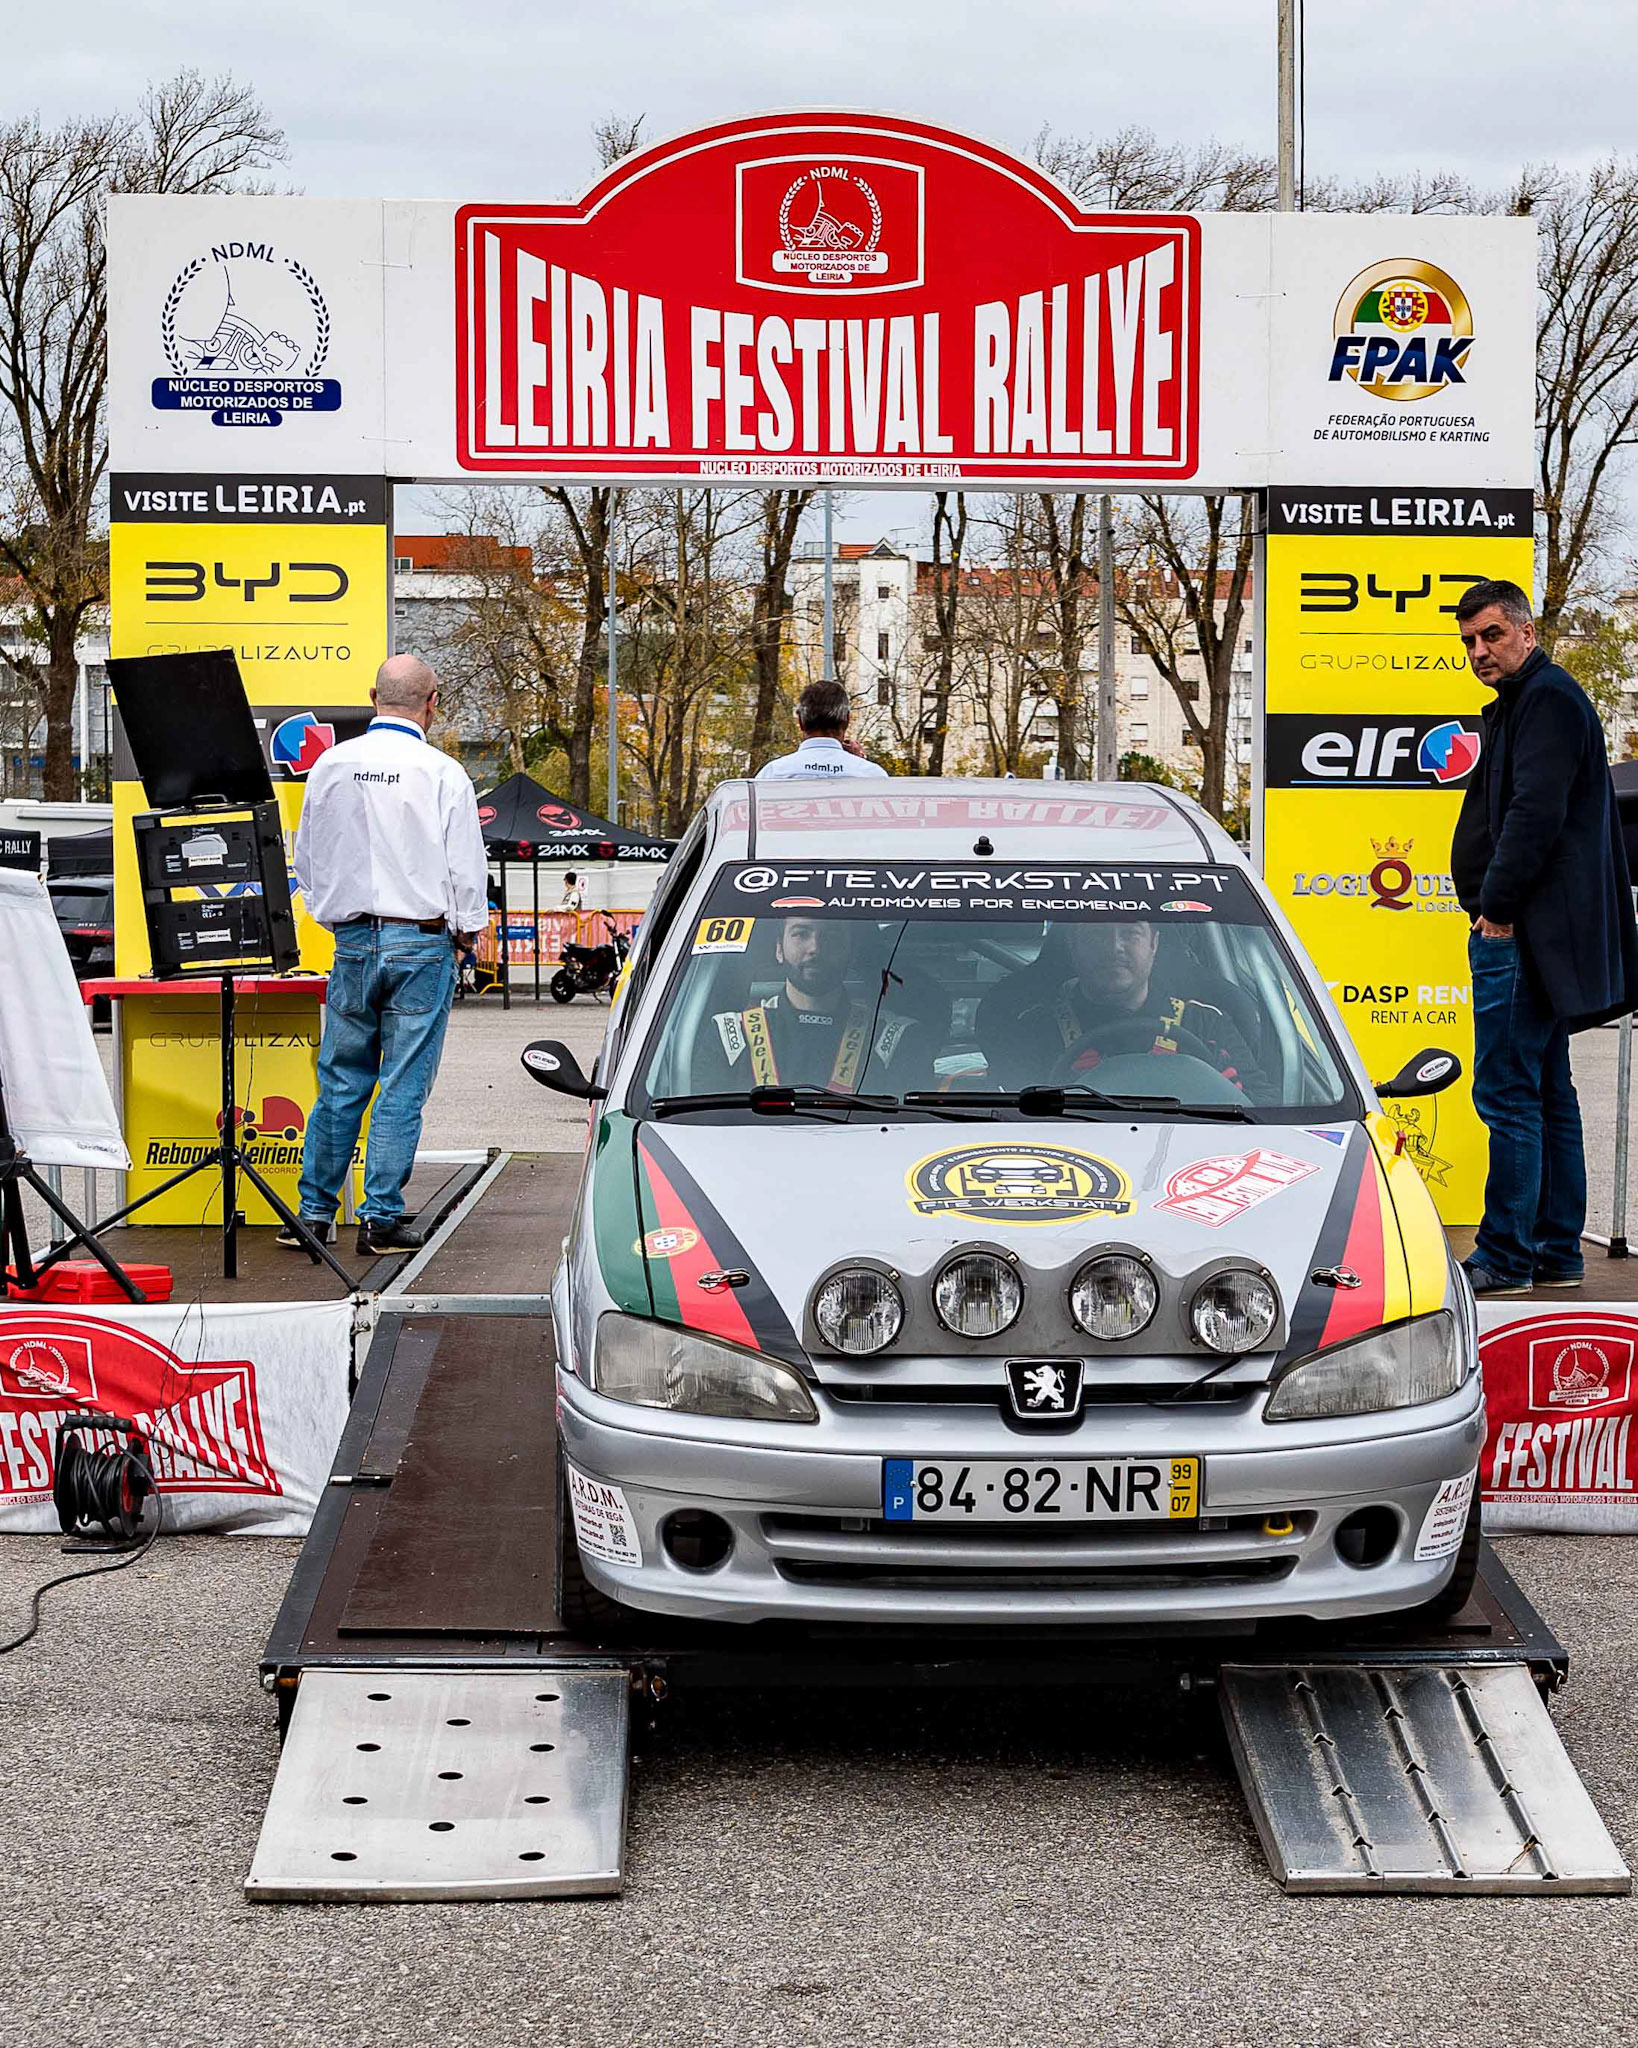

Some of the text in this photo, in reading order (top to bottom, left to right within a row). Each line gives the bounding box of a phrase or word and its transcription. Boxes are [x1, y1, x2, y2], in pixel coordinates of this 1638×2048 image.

[803, 166, 850, 181] NDML
[211, 242, 275, 264] NDML
[822, 253, 877, 262] DESPORTOS
[790, 262, 870, 271] MOTORIZADOS DE
[815, 272, 845, 281] LEIRIA
[484, 229, 1176, 457] LEIRIA FESTIVAL RALLYE
[1328, 335, 1477, 384] FPAK
[168, 376, 325, 394] NÚCLEO DESPORTOS
[180, 396, 314, 409] MOTORIZADOS DE
[222, 411, 272, 425] LEIRIA
[1328, 413, 1476, 428] FEDERAÇÃO PORTUGUESA
[1313, 430, 1491, 443] DE AUTOMOBILISMO E KARTING
[700, 461, 963, 478] NUCLEO DESPORTOS MOTORIZADOS DE LEIRIA
[124, 484, 367, 516] VISITE LEIRIA.pt
[1281, 497, 1516, 529] VISITE LEIRIA.pt
[145, 561, 350, 603] BYD
[1300, 653, 1467, 671] GRUPOLIZAU
[1301, 727, 1416, 777] elf
[804, 762, 844, 775] ndml.pt
[353, 770, 401, 785] ndml.pt
[5, 839, 33, 854] RALLY
[537, 844, 590, 856] 24MX
[617, 846, 668, 859] 24MX
[733, 866, 1230, 894] @FTE.WERKSTATT.PT
[828, 895, 1152, 911] AUTOMÓVEIS POR ENCOMENDA
[706, 919, 745, 943] 60
[1343, 985, 1409, 1003] DASP
[1371, 1011, 1457, 1024] RENT A CAR
[748, 1012, 772, 1086] Sabelt
[257, 1167, 298, 1175] SOCORRO
[921, 1198, 1129, 1211] FTE WERKSTATT
[1570, 1341, 1592, 1351] NDML
[1491, 1414, 1633, 1489] FESTIVAL
[1171, 1474, 1192, 1489] 99
[893, 1497, 905, 1509] P
[1171, 1496, 1191, 1512] 07
